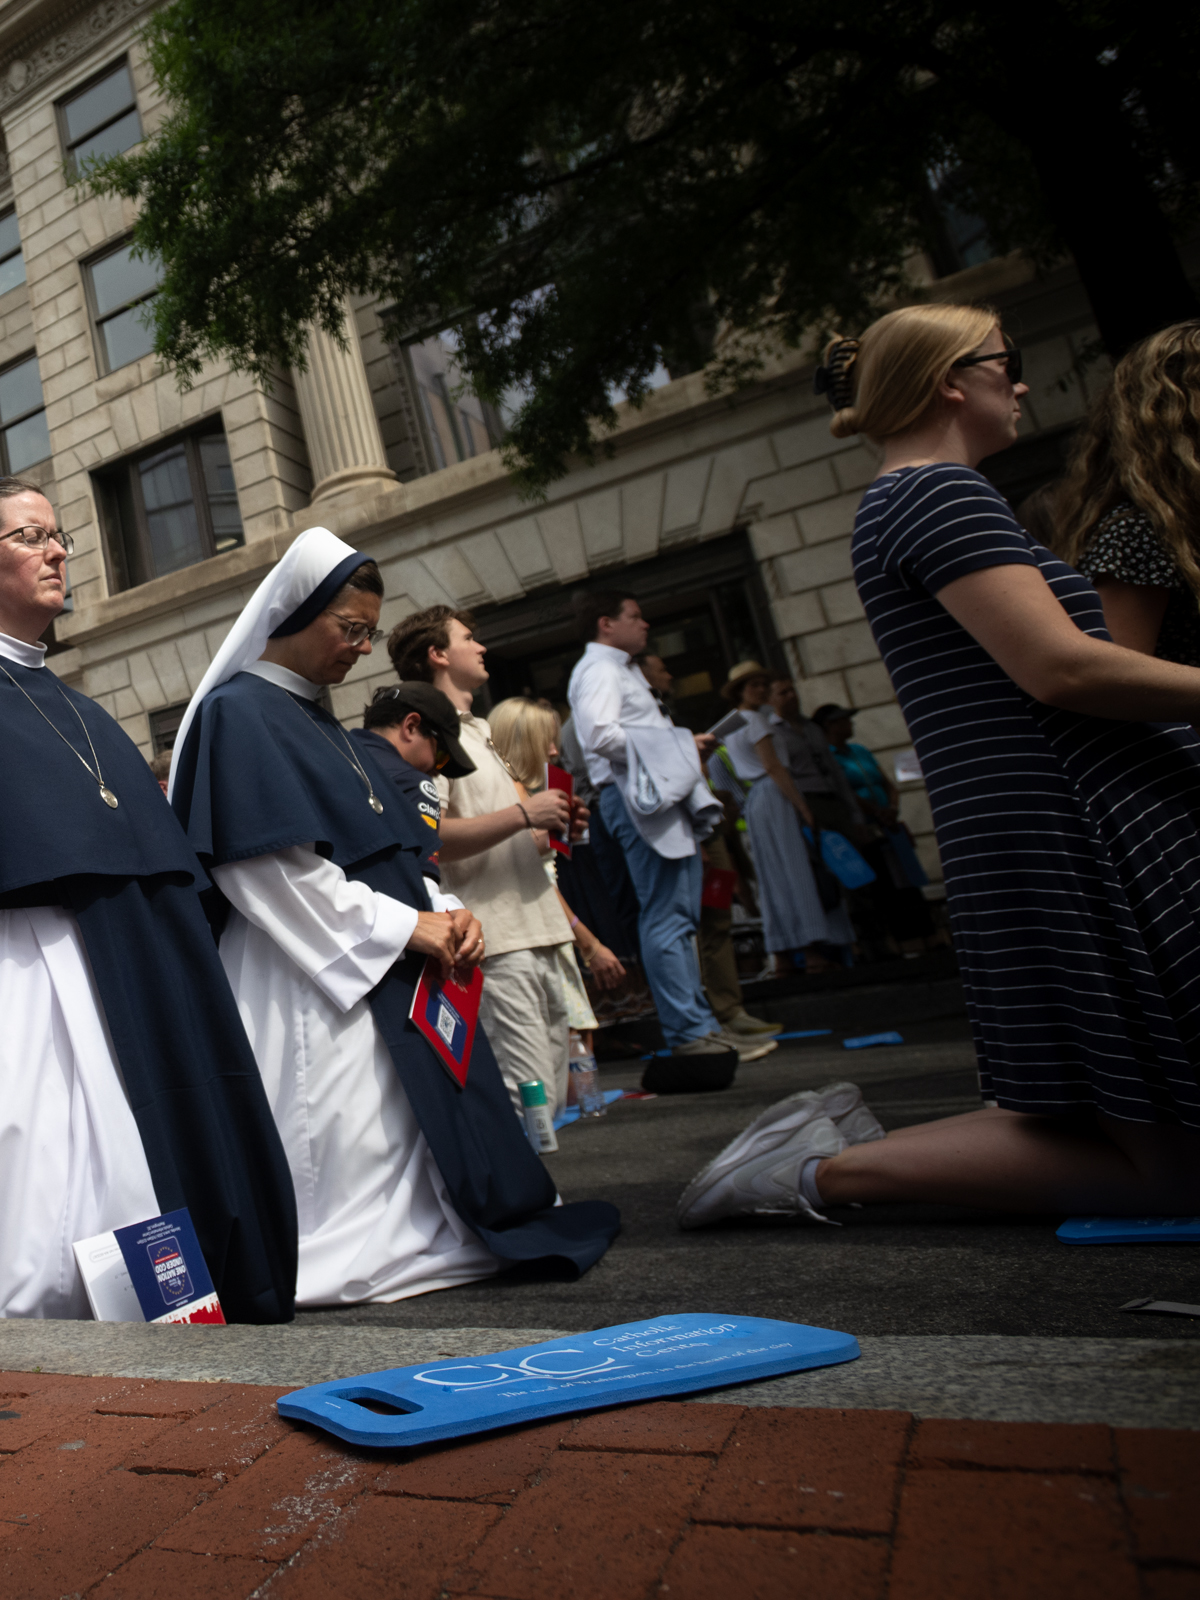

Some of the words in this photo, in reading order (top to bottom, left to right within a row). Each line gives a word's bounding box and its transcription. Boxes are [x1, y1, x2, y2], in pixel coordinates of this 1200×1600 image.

[155, 1263, 167, 1274] GOD
[166, 1256, 183, 1270] UNDER
[157, 1268, 177, 1282] NATION
[175, 1265, 186, 1276] ONE
[593, 1325, 681, 1346] Catholic
[610, 1323, 737, 1352] Information
[635, 1342, 712, 1357] Center
[413, 1348, 615, 1386] CIC
